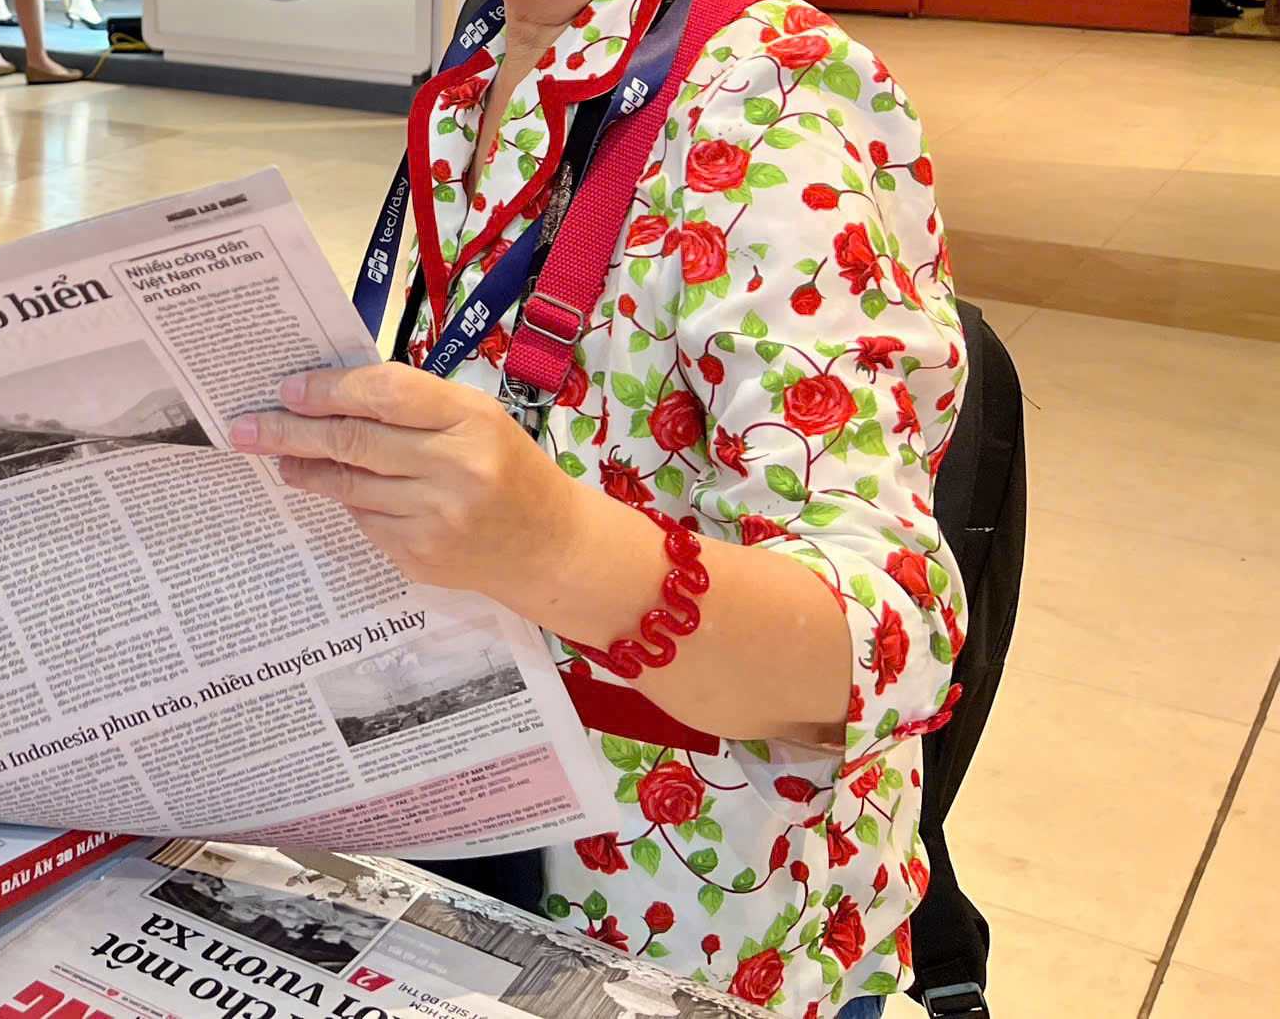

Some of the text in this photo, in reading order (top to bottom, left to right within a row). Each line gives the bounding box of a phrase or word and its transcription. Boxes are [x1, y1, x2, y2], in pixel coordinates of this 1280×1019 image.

[459, 17, 489, 50] FPT
[620, 76, 650, 115] FPT
[125, 240, 249, 279] Nhiều công dân
[132, 251, 265, 291] Việt Nam rời Iran
[367, 248, 389, 284] FPT
[4, 274, 113, 323] biển
[142, 281, 202, 303] an toàn
[460, 300, 491, 338] FPT
[8, 725, 100, 769] Indonesia
[100, 708, 152, 742] phun
[151, 693, 199, 719] trào,
[198, 673, 255, 702] nhiều
[256, 647, 328, 683] chuyến
[326, 633, 364, 658] bay
[361, 622, 389, 644] bị
[386, 610, 427, 634] hủy
[0, 869, 31, 896] DẤU
[33, 857, 54, 880] ẤN
[56, 848, 74, 867] 30
[76, 832, 107, 861] NĂM
[90, 933, 194, 987] một
[189, 977, 278, 1019] cho
[140, 912, 206, 951] xa
[201, 939, 325, 1007] vươn
[356, 969, 381, 988] 2
[397, 982, 420, 998] THỊ
[420, 992, 440, 1006] ĐÔ
[439, 1001, 471, 1018] SIÊU
[409, 1000, 440, 1019] HCM
